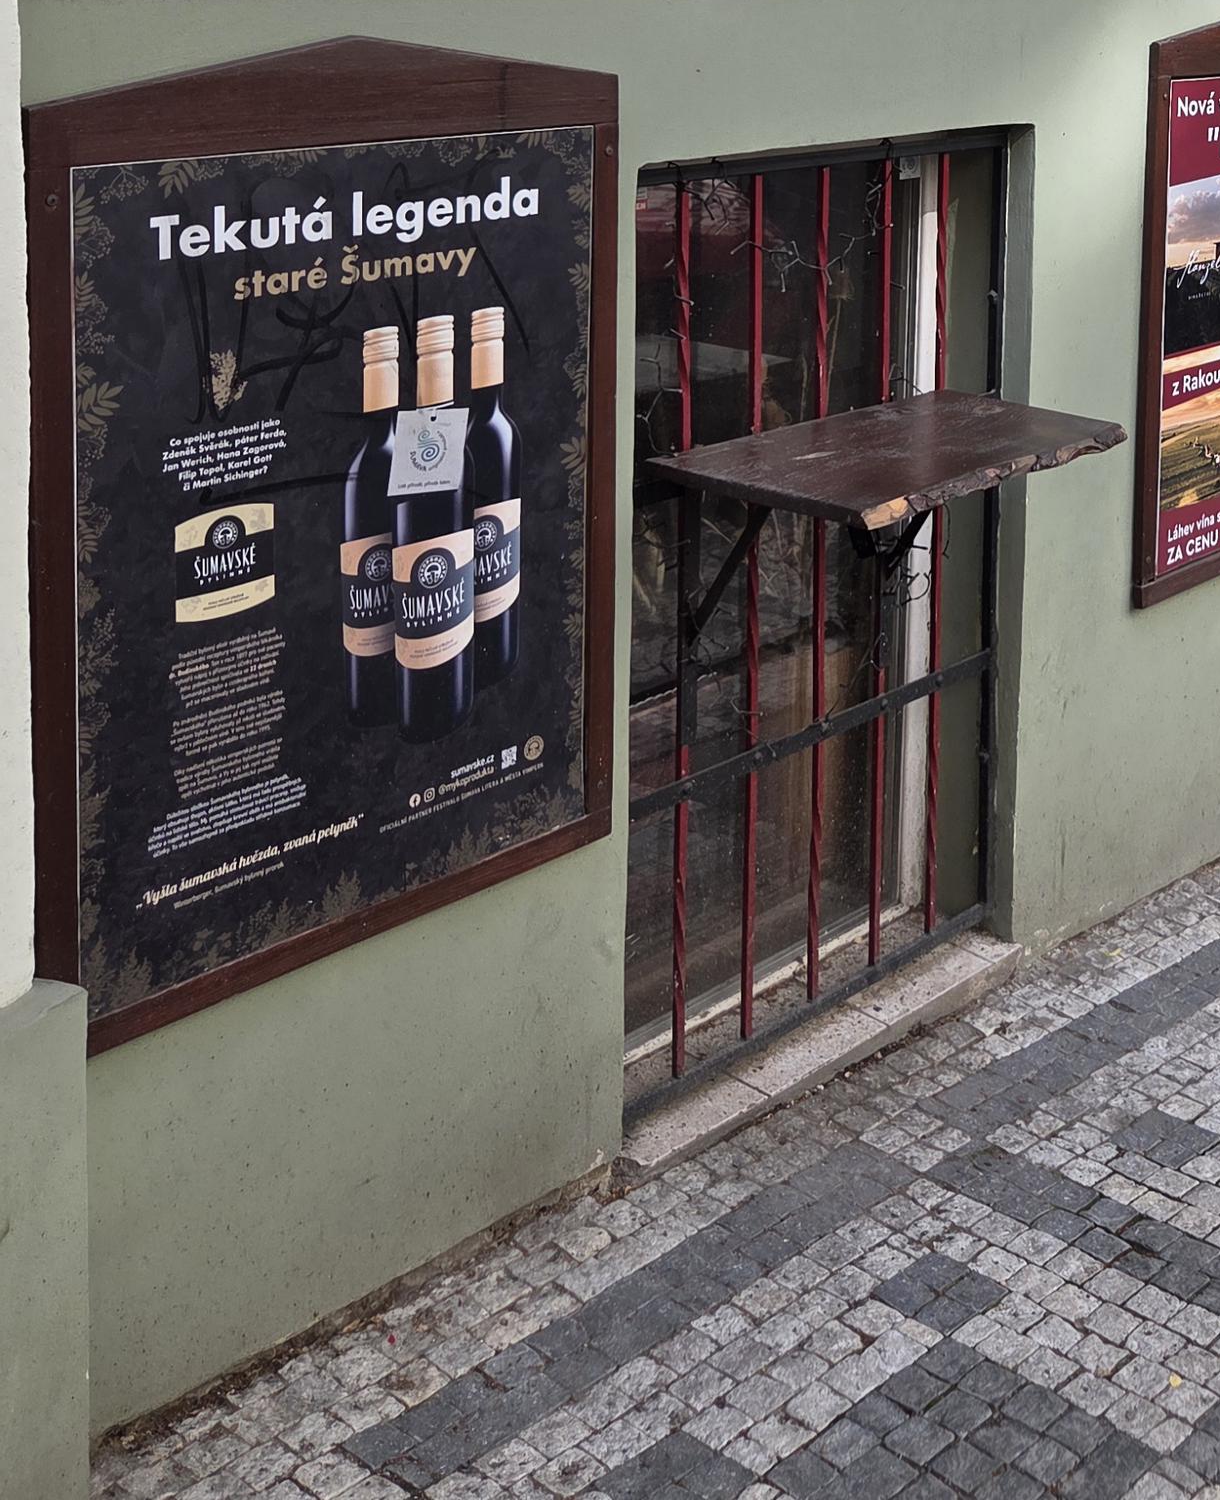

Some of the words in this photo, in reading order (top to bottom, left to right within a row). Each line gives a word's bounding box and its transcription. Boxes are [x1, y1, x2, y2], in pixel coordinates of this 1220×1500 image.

[1177, 91, 1215, 117] Nová
[150, 197, 333, 260] Tekutá
[352, 176, 539, 243] legenda
[234, 259, 328, 300] staré
[341, 245, 476, 286] Šumavy
[1172, 381, 1180, 396] z
[162, 446, 197, 461] Zdeněk
[199, 439, 233, 454] Svěrák,
[235, 434, 259, 448] páter
[261, 428, 287, 440] Ferda,
[170, 438, 182, 447] Co
[184, 431, 216, 446] spojuje
[218, 421, 260, 437] osobnosti
[261, 418, 281, 431] jako
[162, 463, 179, 473] Jan
[181, 455, 214, 469] Werich,
[217, 449, 241, 461] Hana
[179, 471, 197, 481] Filip
[228, 457, 251, 470] Karel
[253, 454, 273, 465] Gott
[193, 476, 222, 490] Martin
[224, 464, 269, 483] Sichinger?
[1167, 519, 1195, 543] Láhev
[1196, 510, 1216, 530] vína
[194, 542, 256, 580] ŠUMAVSKÉ
[1167, 546, 1183, 566] ZA
[1185, 531, 1219, 557] CENU
[402, 577, 465, 619] ŠUMAVSKÉ
[450, 754, 495, 779] sumavske.cz
[179, 858, 238, 892] šumavská
[239, 845, 282, 870] hvězda,
[283, 829, 317, 853] zvaná
